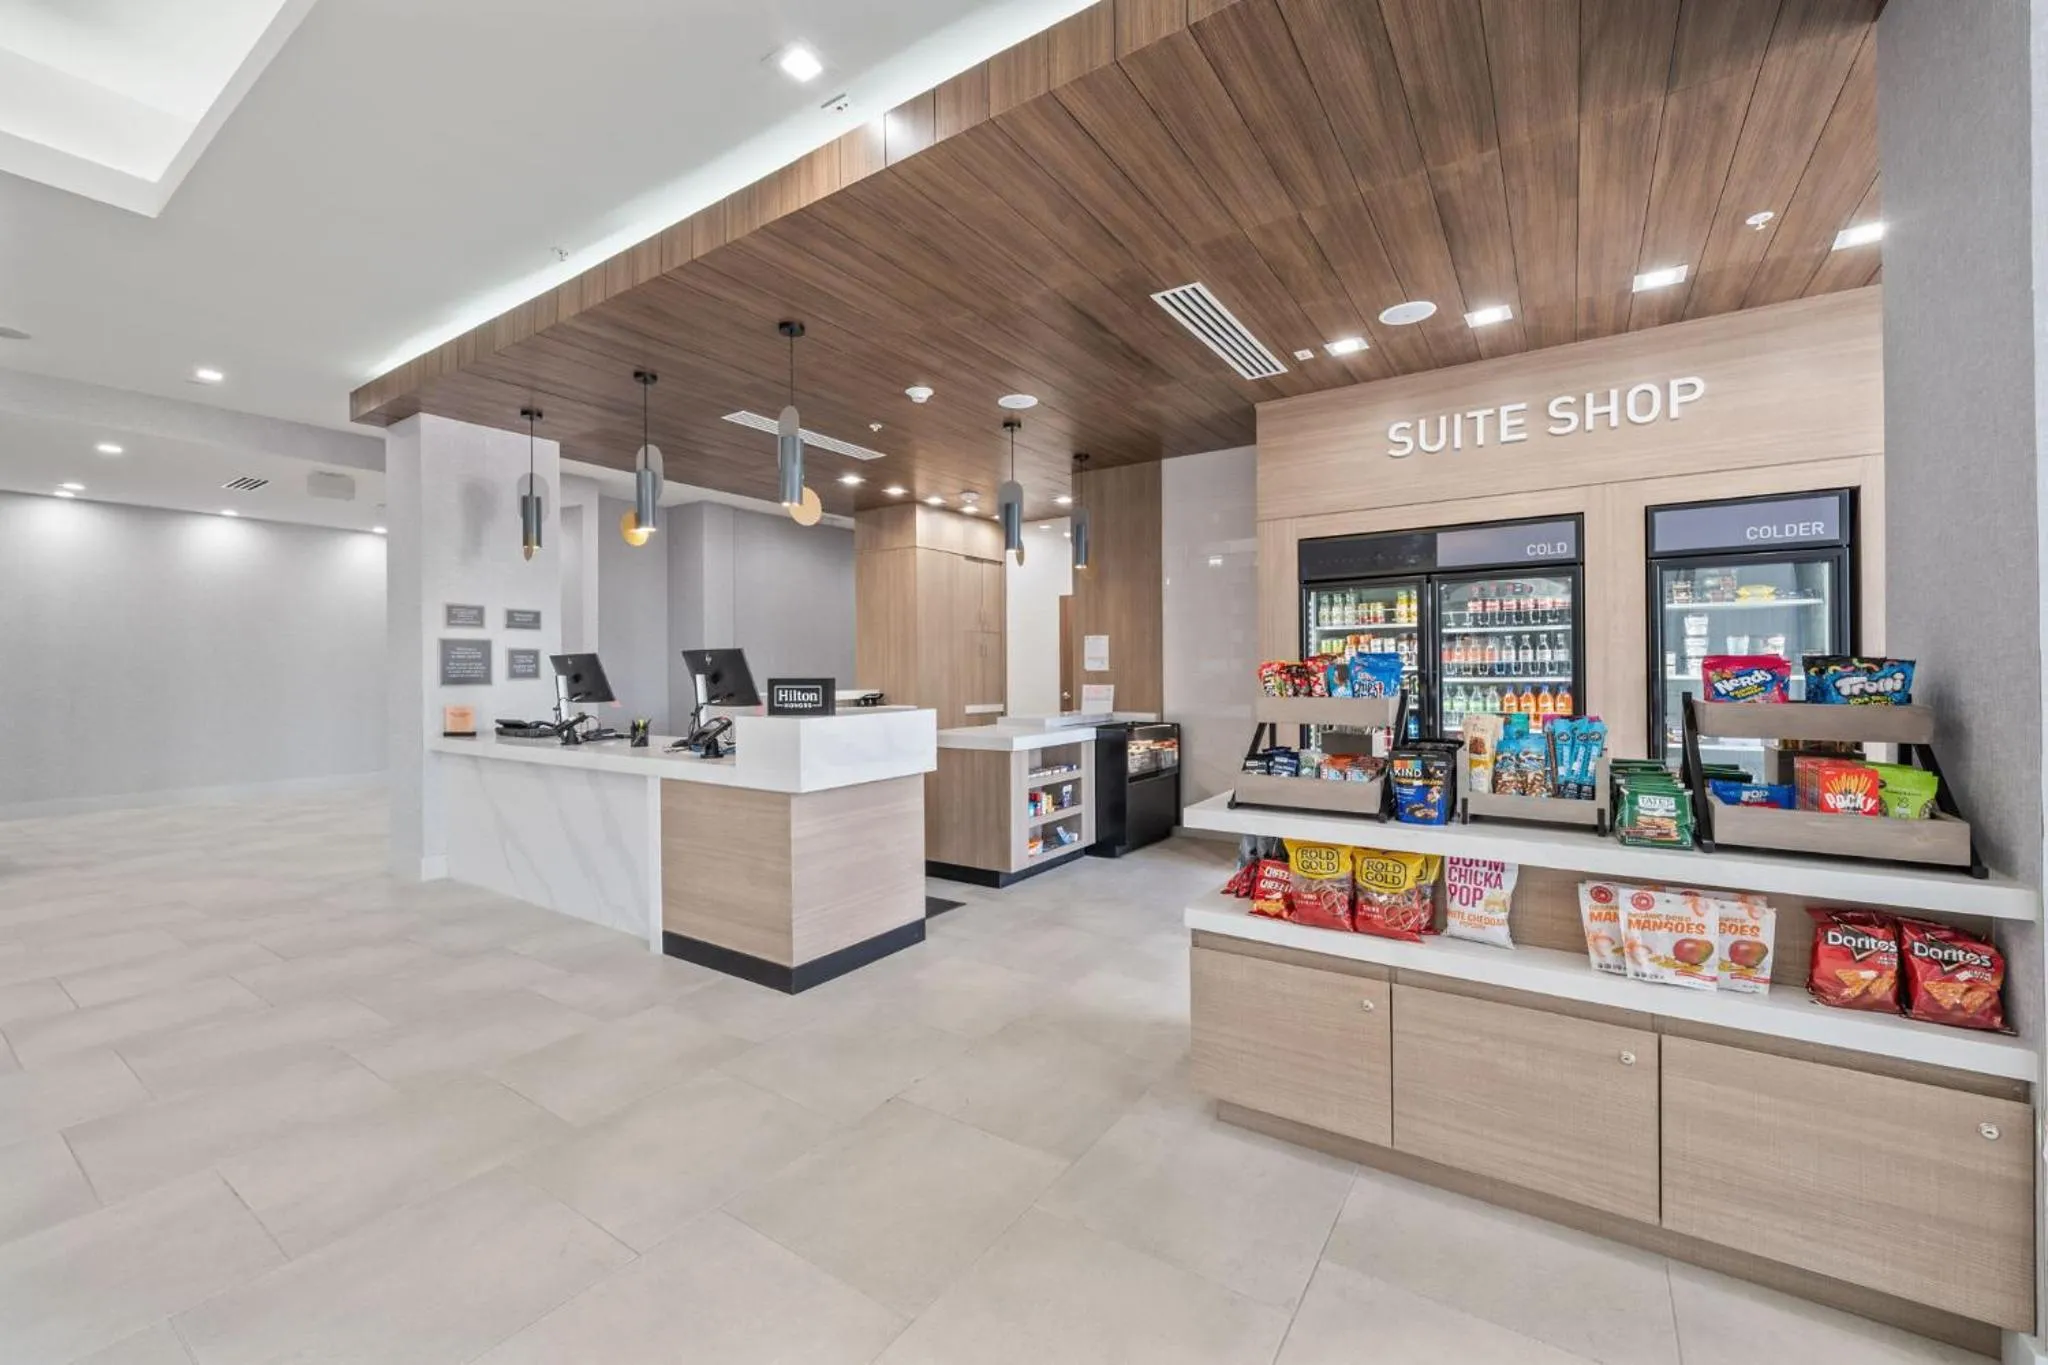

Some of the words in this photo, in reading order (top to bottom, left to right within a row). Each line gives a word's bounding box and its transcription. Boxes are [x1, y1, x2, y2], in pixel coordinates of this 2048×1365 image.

[1387, 402, 1529, 458] SUITE
[1547, 375, 1705, 436] SHOP
[1746, 521, 1825, 541] COLDER
[1526, 541, 1568, 557] COLD
[1714, 669, 1772, 696] Nerds
[1835, 671, 1905, 697] Trolli
[778, 688, 819, 702] Hilton
[1394, 767, 1422, 778] KIND
[1824, 792, 1877, 813] Pocky
[1300, 847, 1335, 861] ROLD
[1300, 859, 1336, 872] GOLD
[1366, 859, 1402, 875] ROLD
[1365, 870, 1401, 886] GOLD
[1448, 866, 1504, 890] CHICKA
[1448, 883, 1484, 908] POP
[1627, 918, 1706, 936] MANGOES
[1719, 921, 1761, 937] GOES
[1827, 930, 1898, 953] Doritos
[1913, 942, 1992, 968] Doritos
